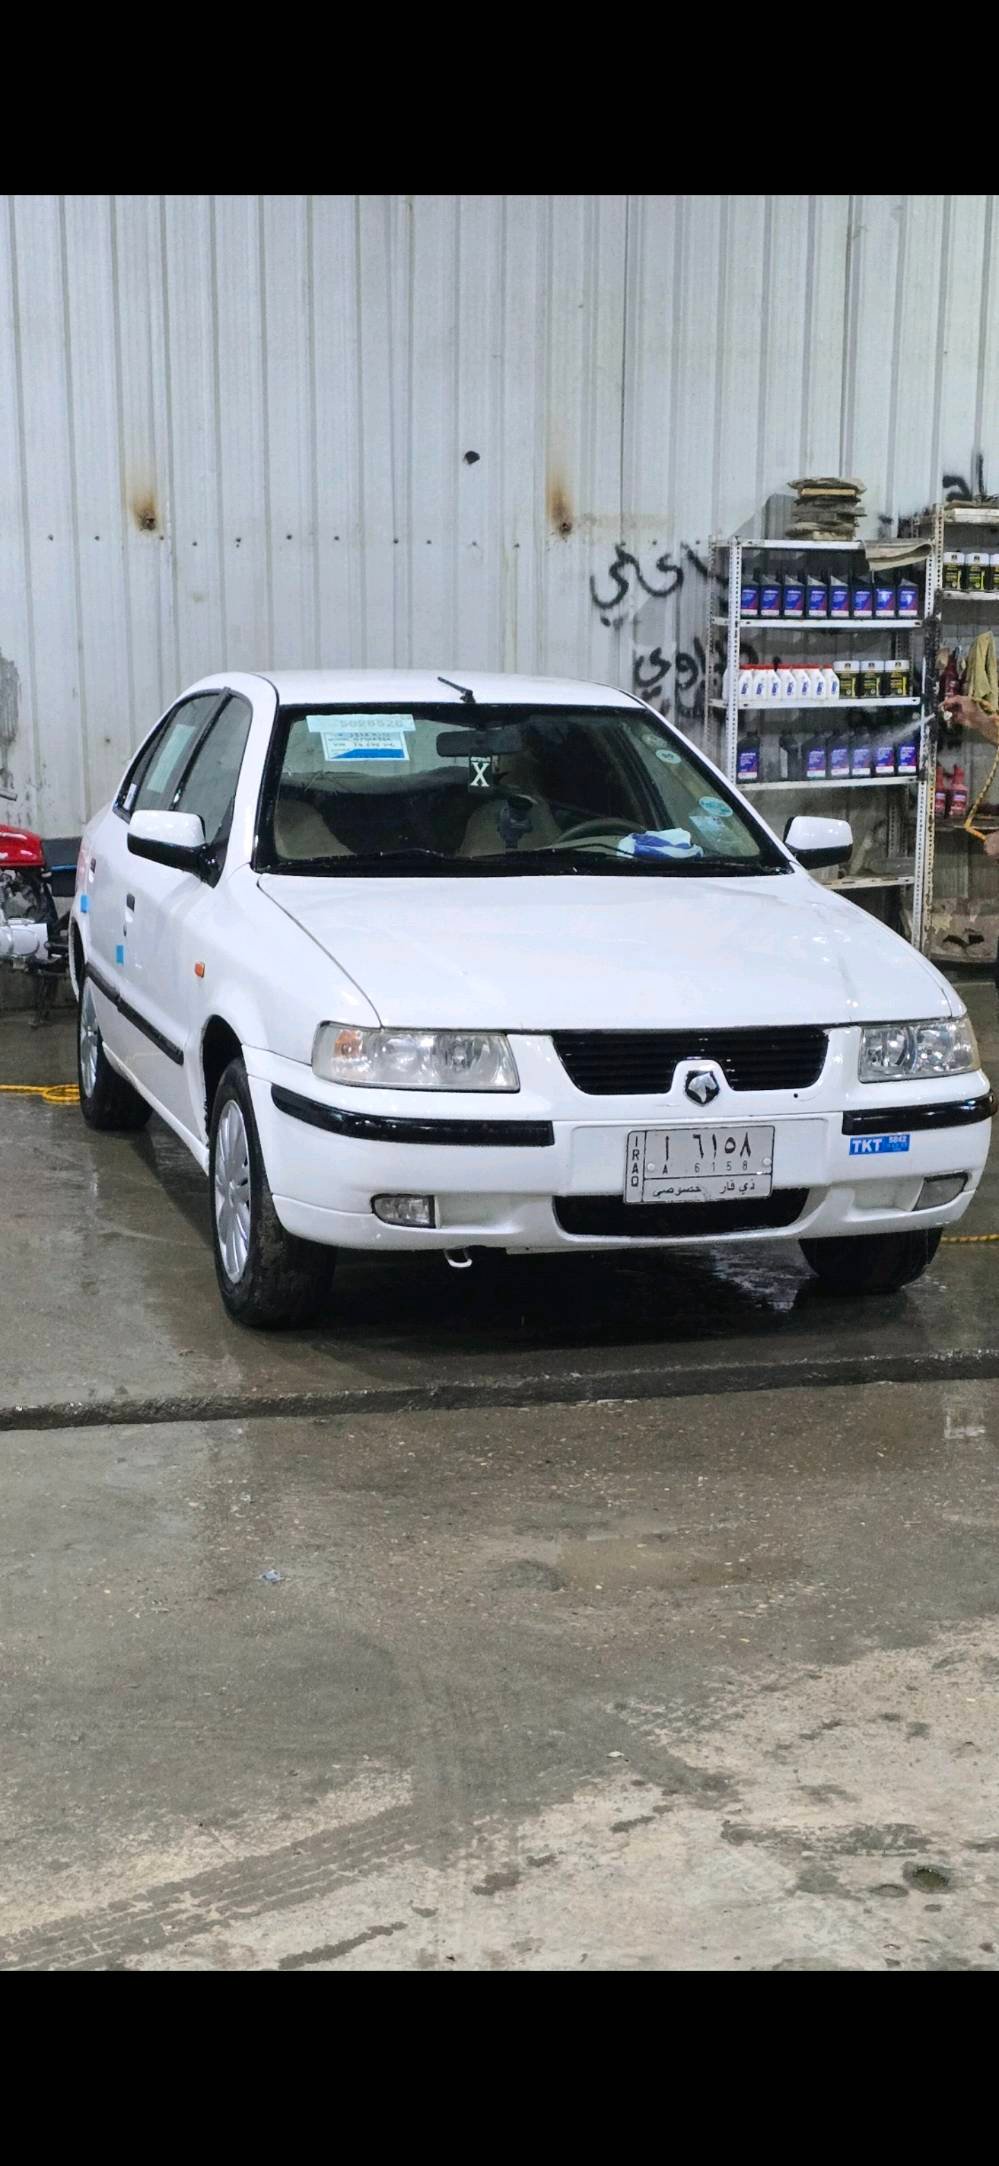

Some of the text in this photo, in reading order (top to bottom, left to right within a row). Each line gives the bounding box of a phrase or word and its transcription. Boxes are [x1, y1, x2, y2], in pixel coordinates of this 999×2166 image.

[470, 761, 490, 787] X
[692, 1131, 752, 1159] ٦١٥٨
[852, 1138, 882, 1153] TKT
[631, 1135, 640, 1188] IRAQ
[662, 1161, 748, 1174] A 6158
[719, 1179, 735, 1194] قار
